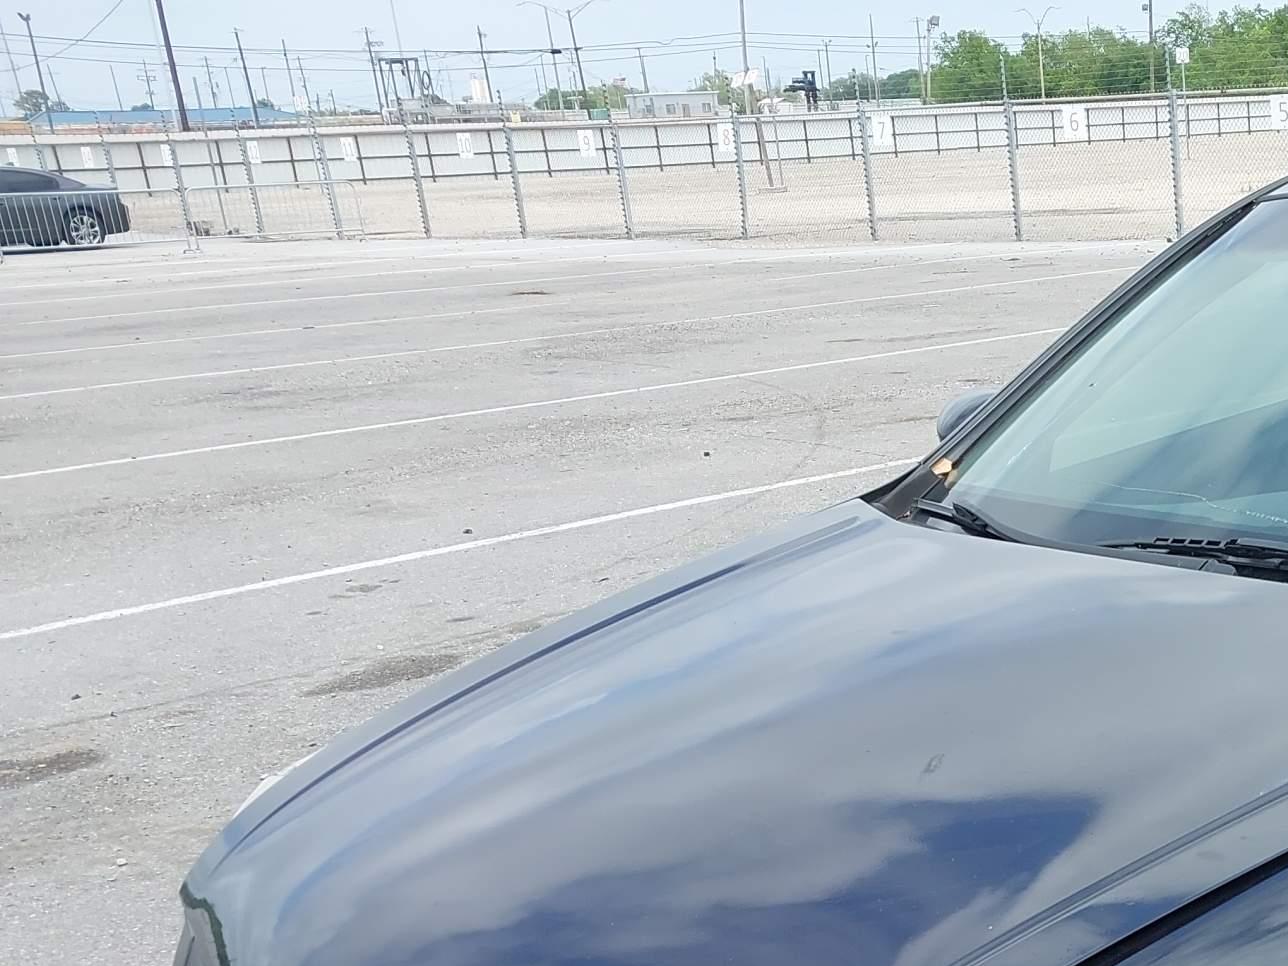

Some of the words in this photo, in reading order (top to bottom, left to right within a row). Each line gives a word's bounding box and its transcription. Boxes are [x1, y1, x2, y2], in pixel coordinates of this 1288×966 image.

[1278, 101, 1288, 122] 5
[877, 121, 885, 140] 7
[1069, 111, 1079, 132] 6
[458, 136, 472, 154] 10
[582, 135, 591, 151] 9
[722, 128, 730, 146] 8
